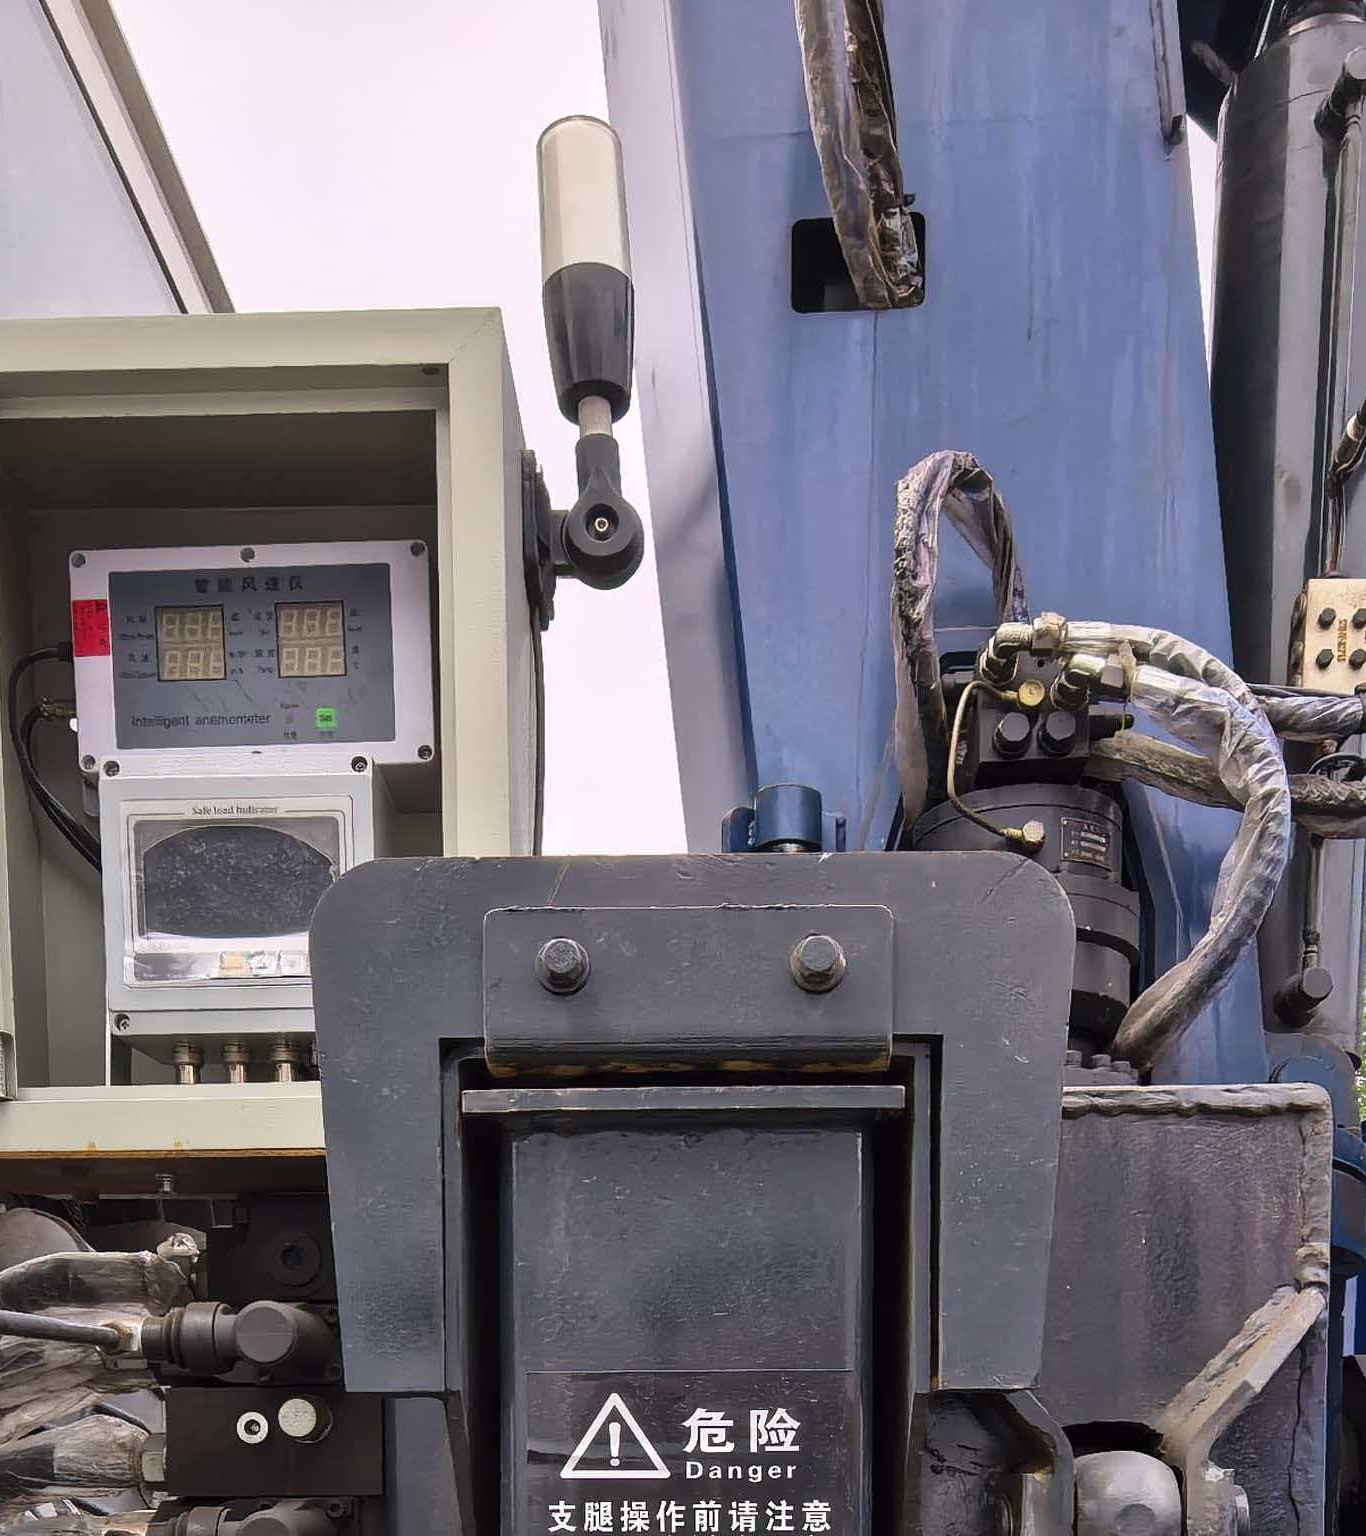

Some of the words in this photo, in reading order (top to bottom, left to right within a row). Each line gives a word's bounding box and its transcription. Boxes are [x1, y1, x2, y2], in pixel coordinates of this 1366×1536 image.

[131, 714, 189, 730] Intelligent
[682, 1407, 802, 1453] 危险
[686, 1461, 798, 1483] Danger
[548, 1499, 832, 1533] 支腿操作前请注意
